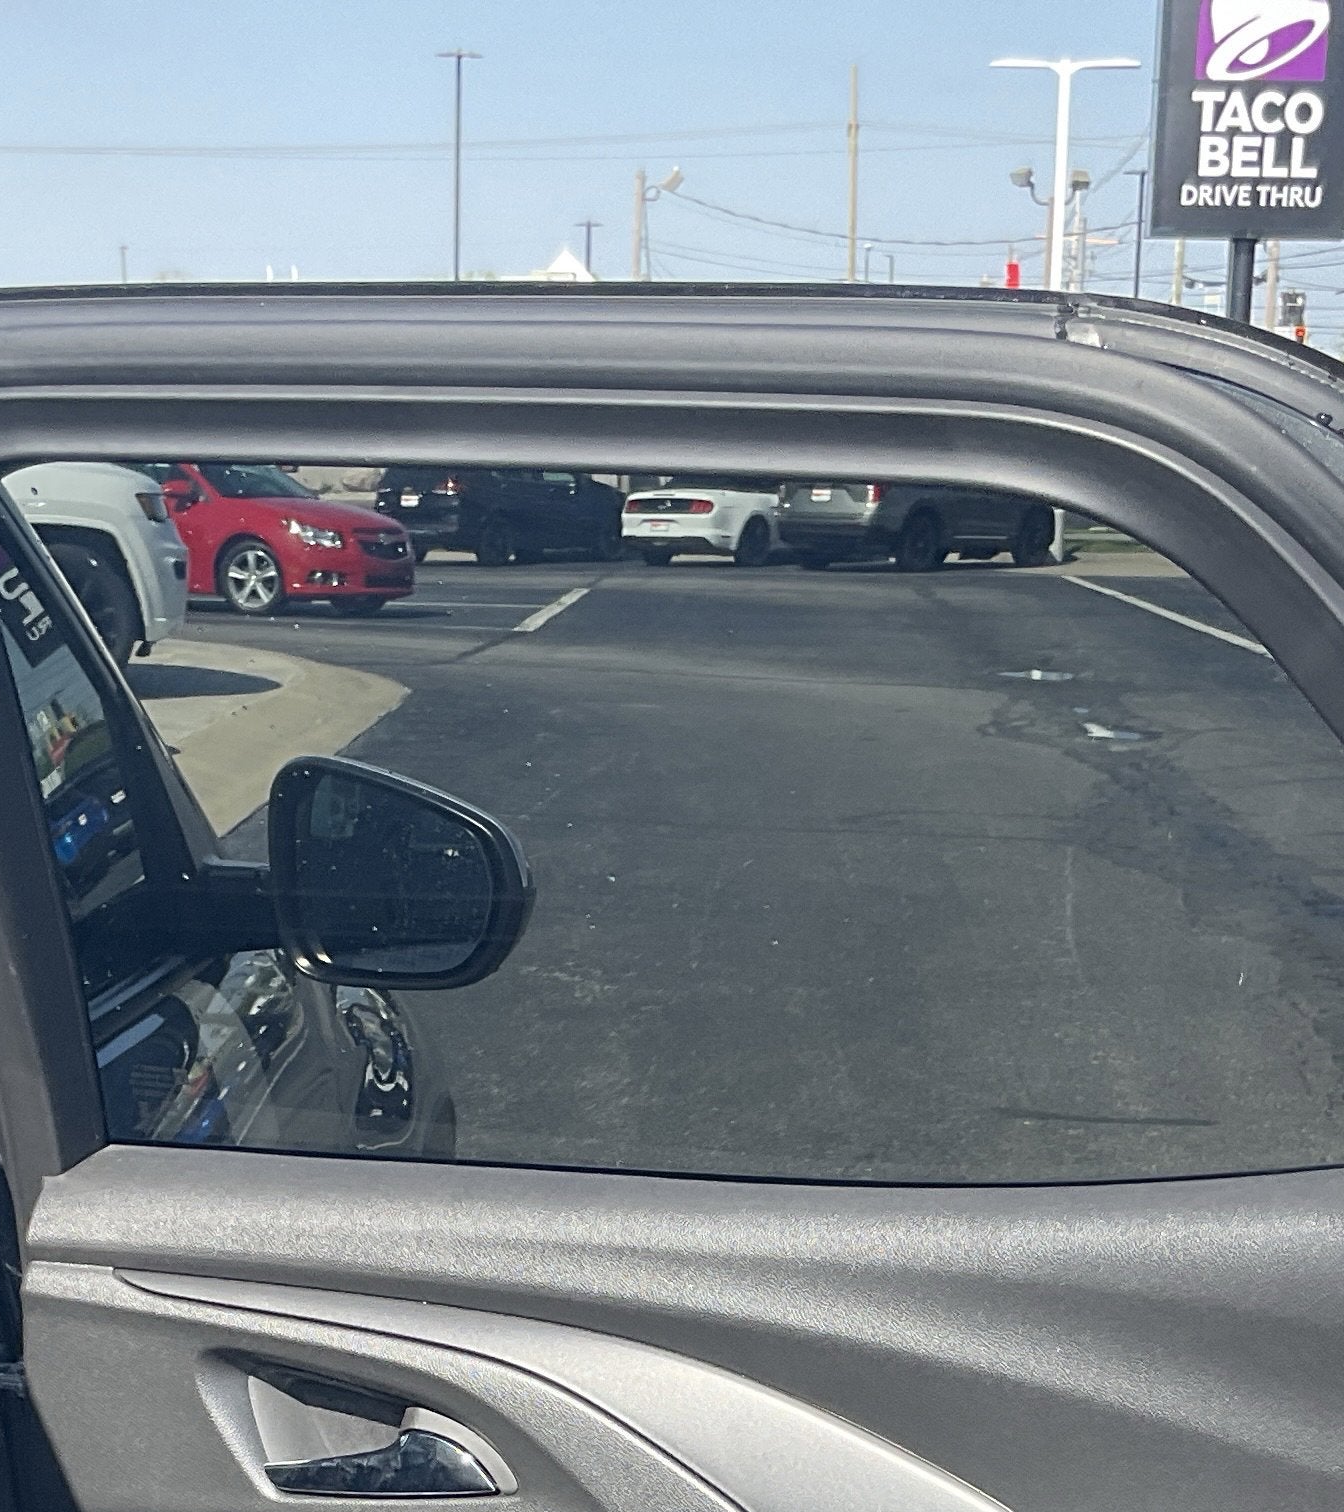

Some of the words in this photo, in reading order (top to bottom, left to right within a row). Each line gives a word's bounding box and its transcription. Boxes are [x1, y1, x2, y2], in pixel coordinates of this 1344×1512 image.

[1191, 90, 1324, 134] TACO
[1197, 136, 1318, 179] BELL
[1180, 184, 1252, 207] DRIVE
[1256, 185, 1323, 208] THRU
